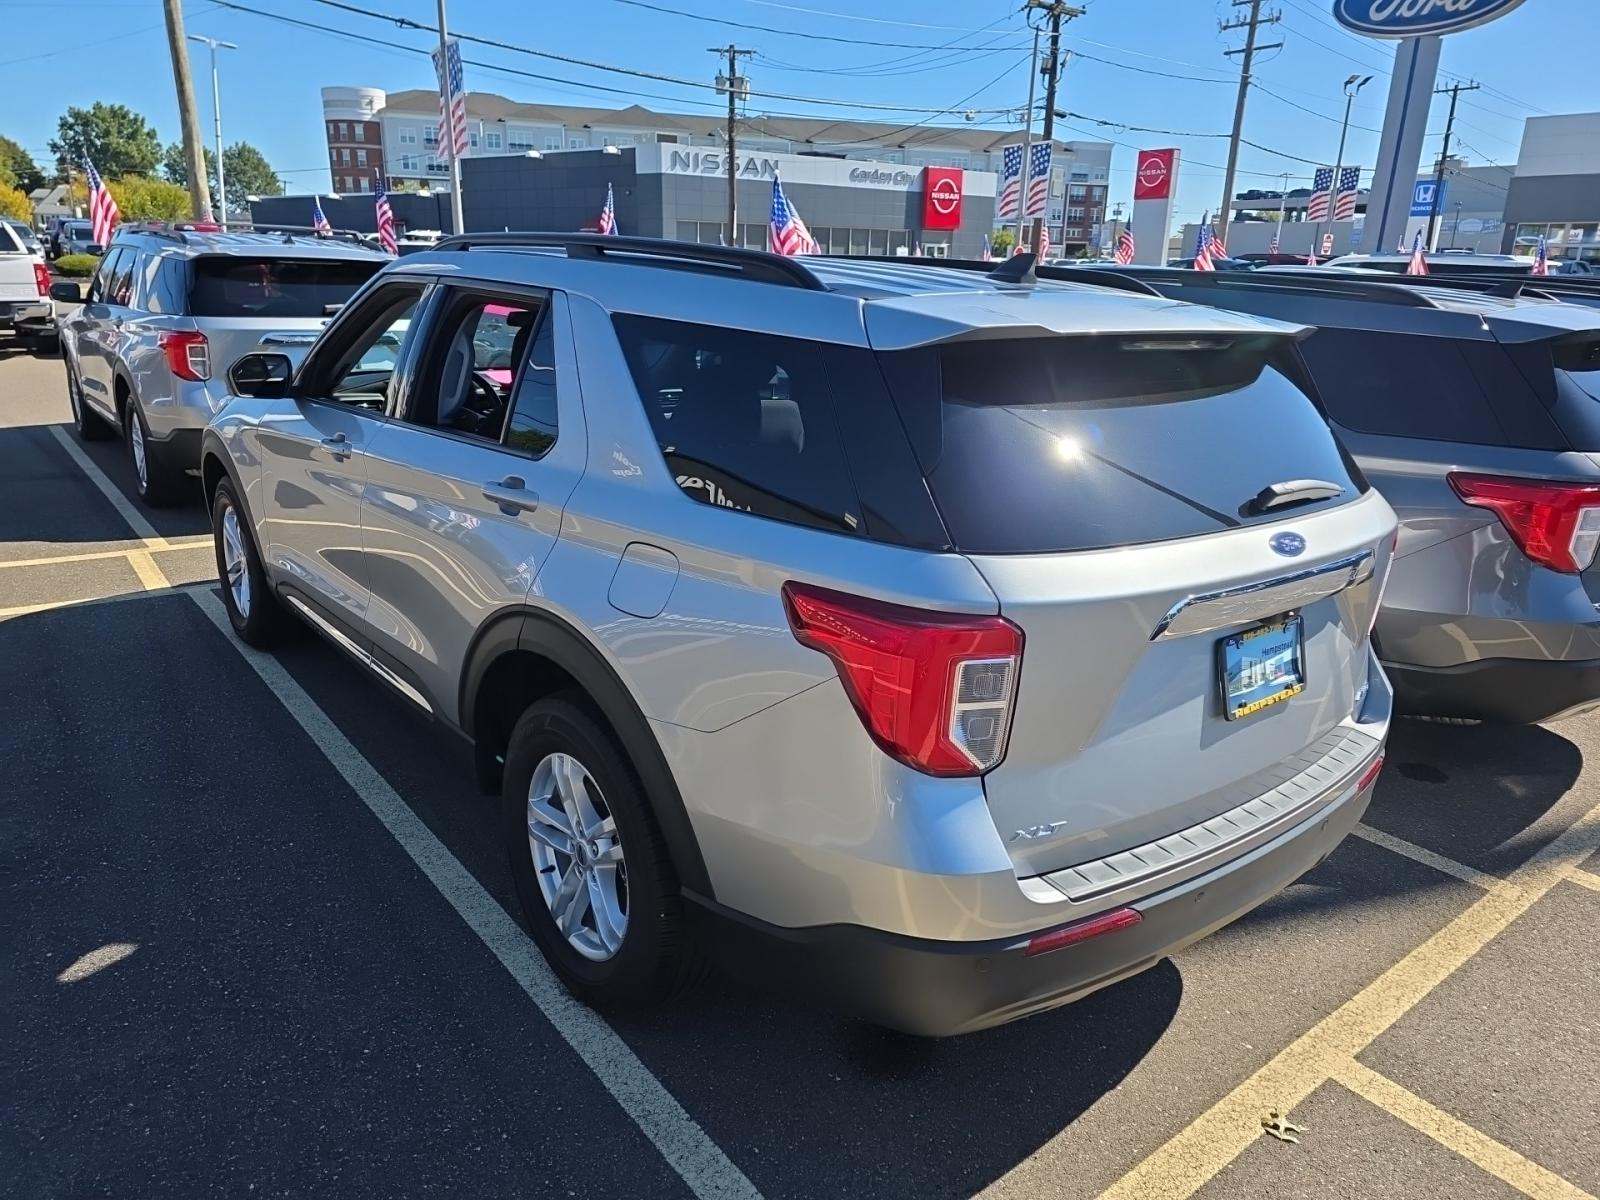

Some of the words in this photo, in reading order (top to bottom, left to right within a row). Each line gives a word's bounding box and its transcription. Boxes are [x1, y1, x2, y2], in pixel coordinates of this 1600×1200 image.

[1369, 0, 1475, 22] or
[670, 151, 779, 178] NISSAN
[849, 168, 892, 184] Garden
[893, 171, 916, 186] City
[931, 192, 960, 200] NISSAN
[1235, 685, 1302, 718] HEMPSTEAD
[1009, 820, 1068, 842] XLT
